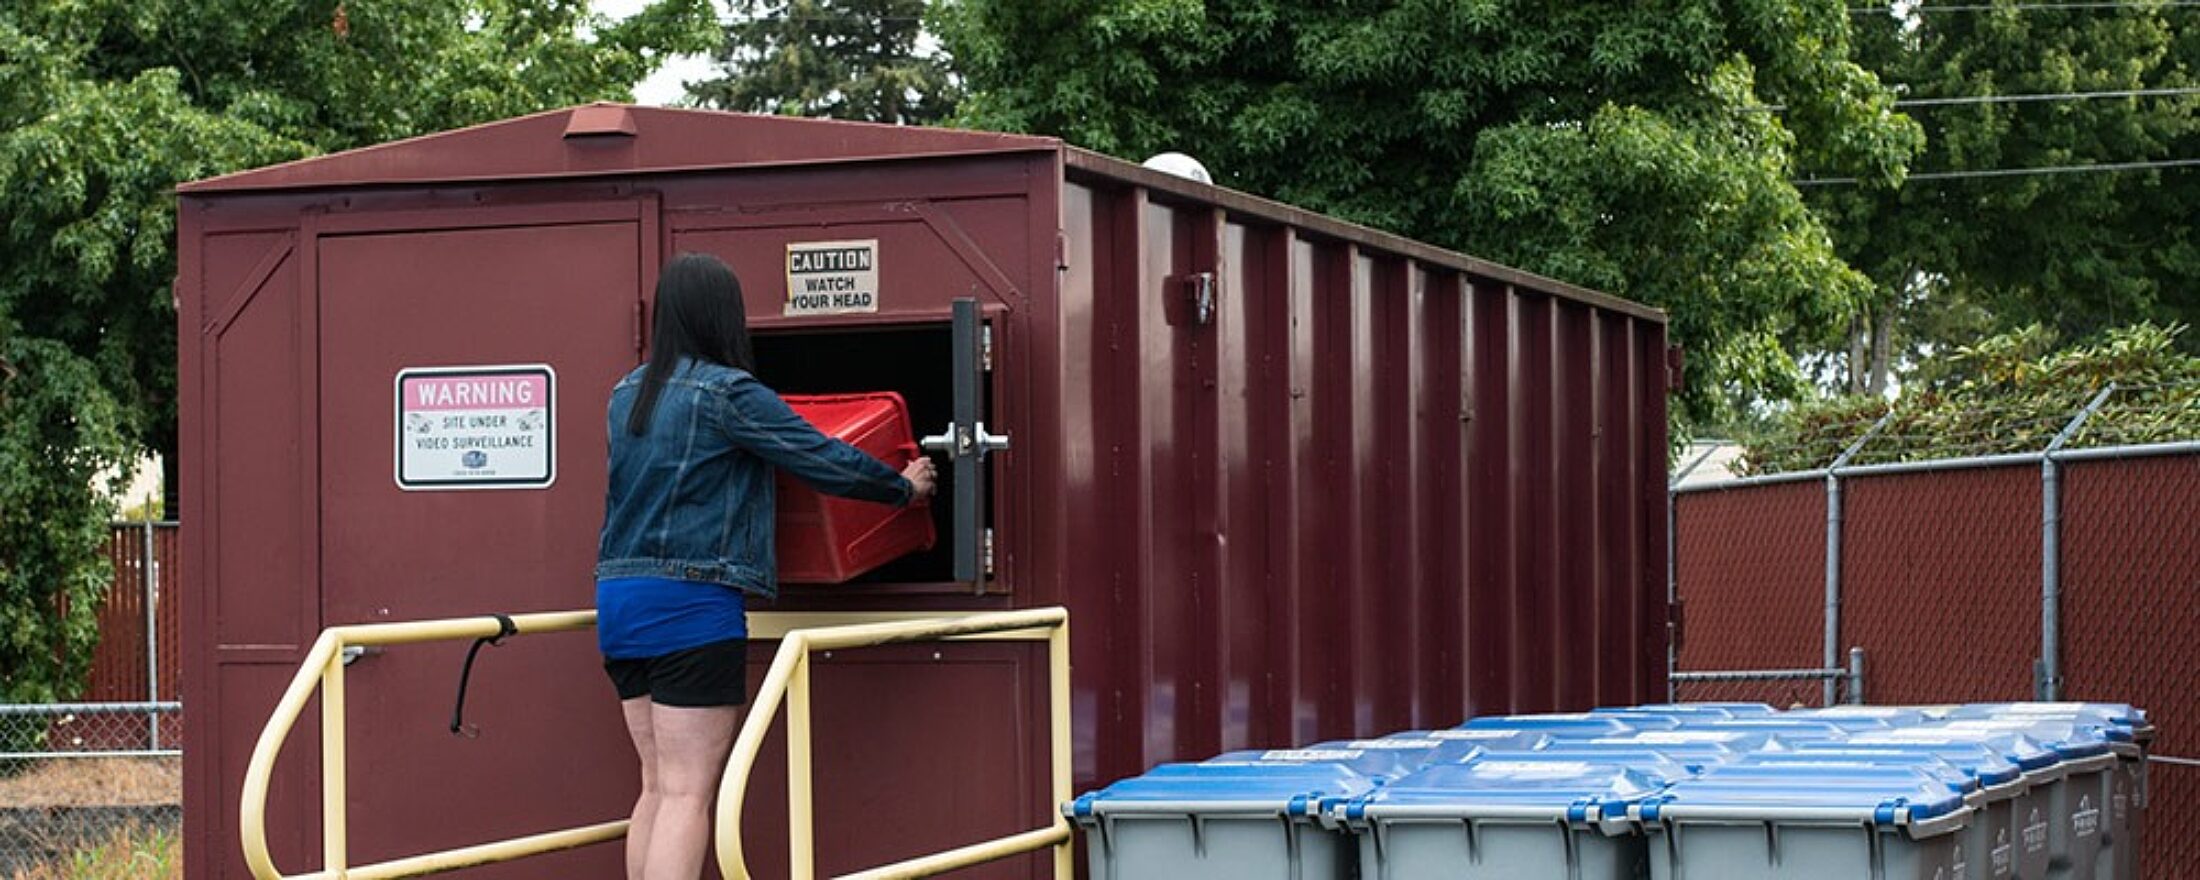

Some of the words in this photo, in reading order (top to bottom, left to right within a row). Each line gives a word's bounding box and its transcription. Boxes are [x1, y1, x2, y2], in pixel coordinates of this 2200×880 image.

[791, 250, 870, 271] CAUTION
[805, 277, 855, 291] WATCH
[832, 293, 872, 307] HEAD
[418, 380, 532, 405] WARNING
[443, 416, 465, 429] SITE
[469, 415, 507, 428] UNDER
[416, 437, 449, 449] VIDEO
[453, 435, 533, 449] SURVEILLANCE
